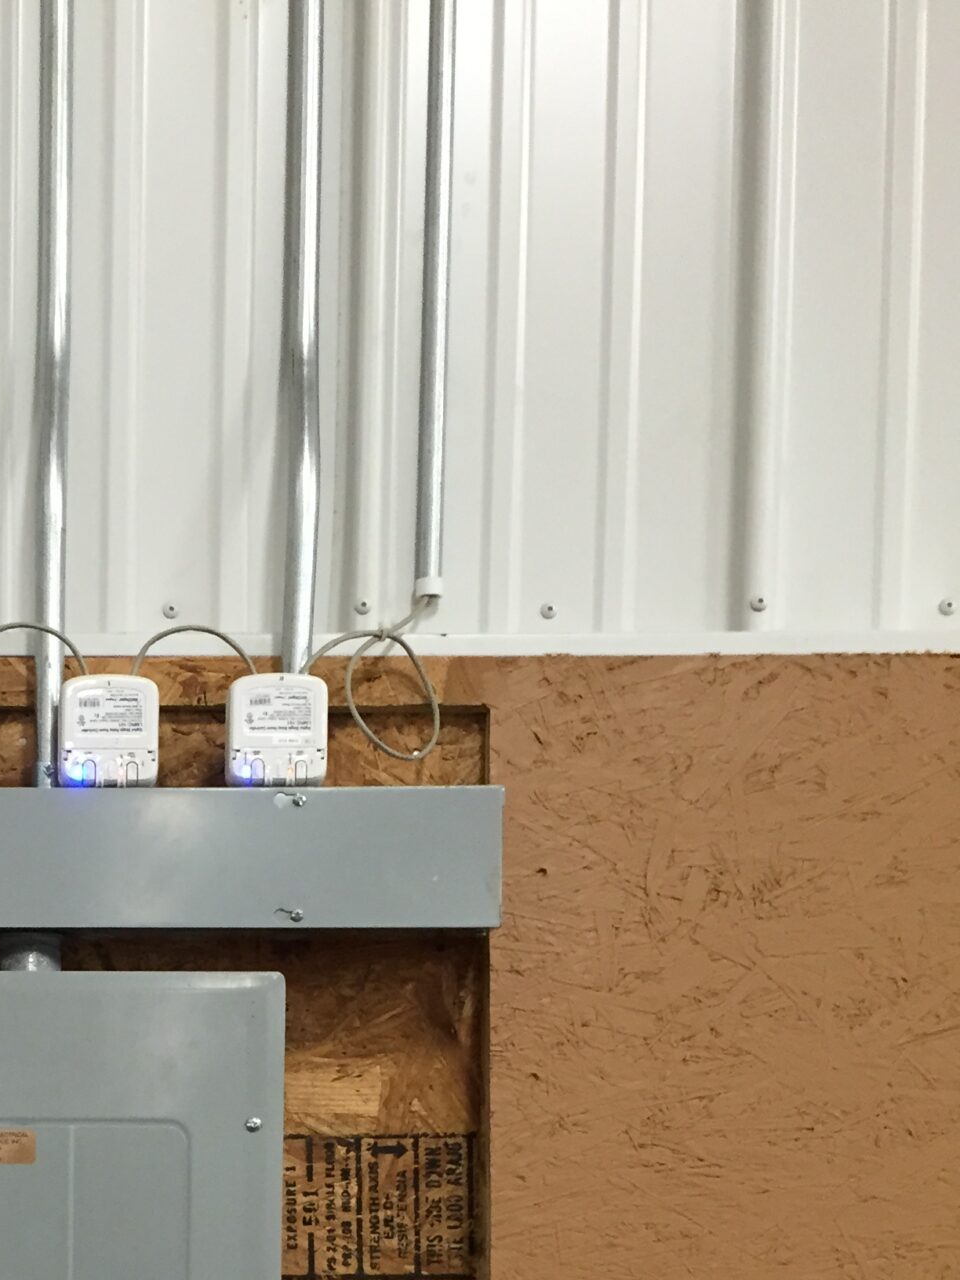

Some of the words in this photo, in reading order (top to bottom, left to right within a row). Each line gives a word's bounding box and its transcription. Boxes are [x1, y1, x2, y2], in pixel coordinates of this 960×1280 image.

[368, 1161, 380, 1193] AXIS
[285, 1180, 298, 1250] EXPOSURE
[368, 1196, 380, 1270] STRENGTH
[426, 1235, 444, 1266] THIS
